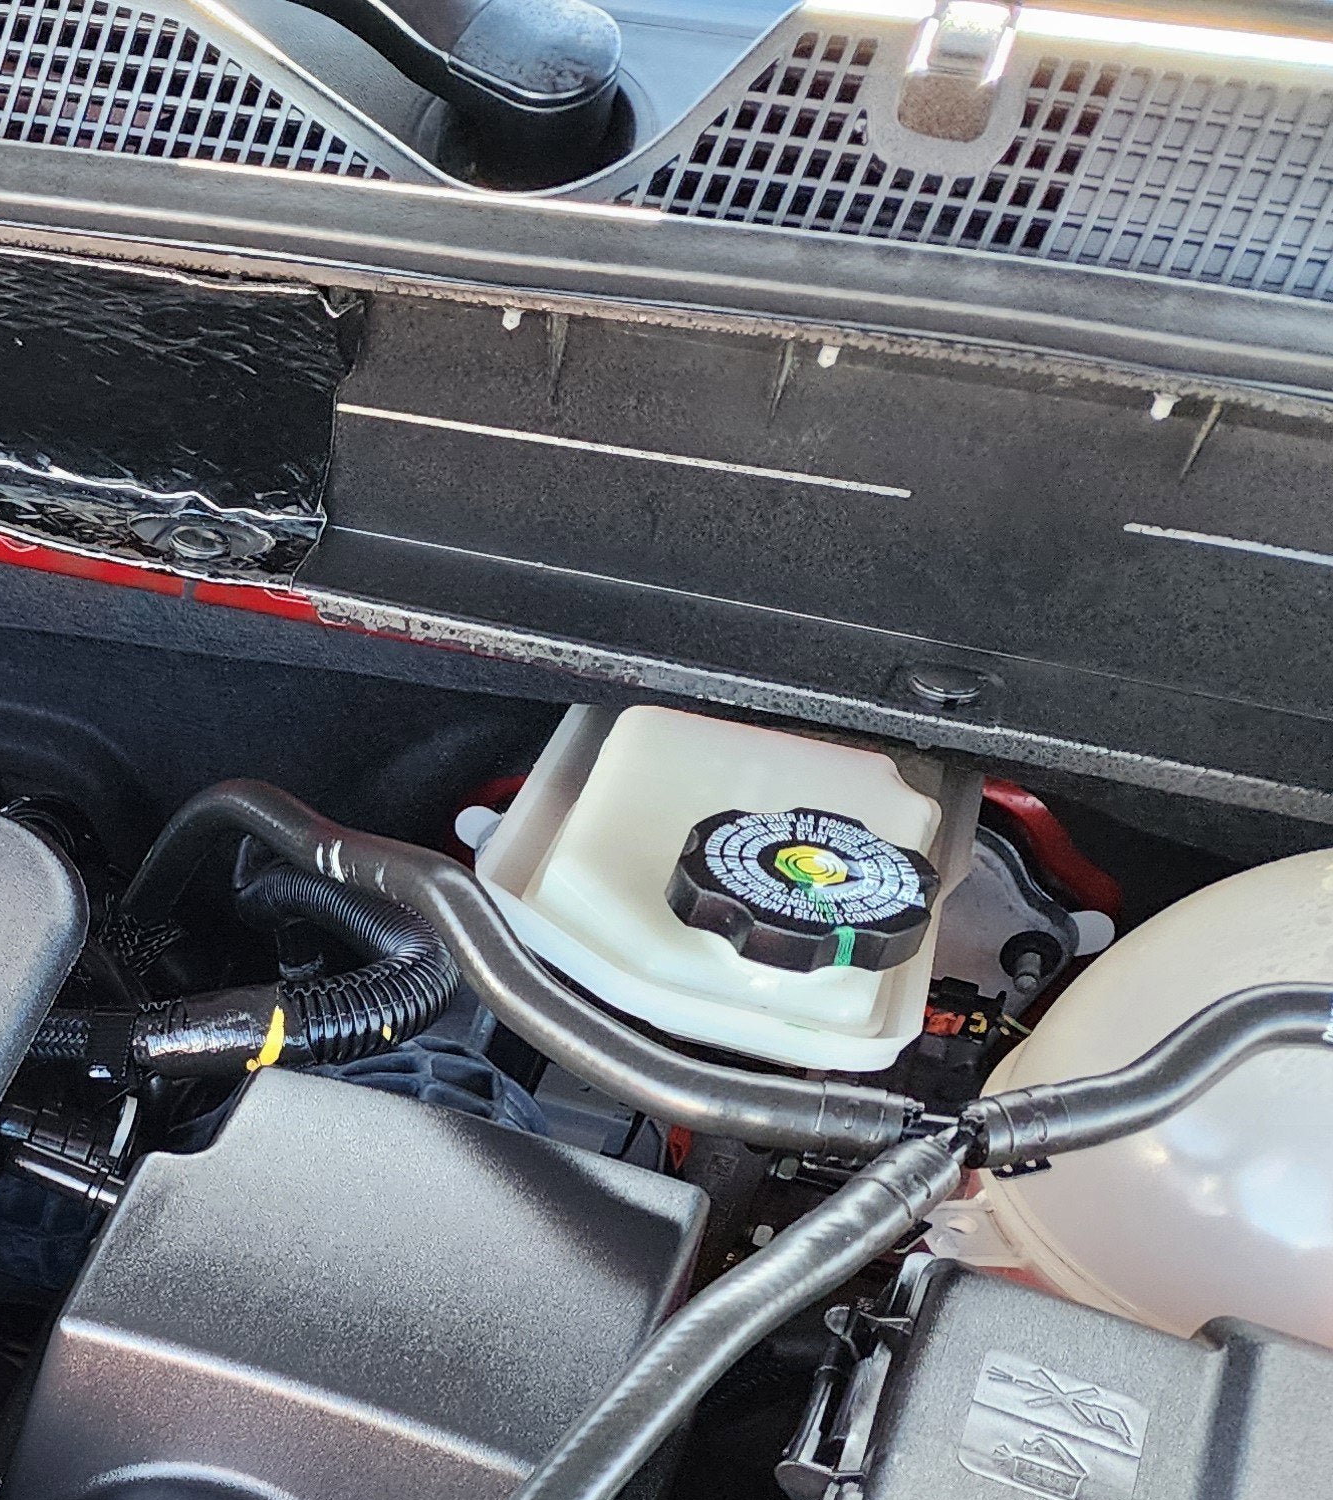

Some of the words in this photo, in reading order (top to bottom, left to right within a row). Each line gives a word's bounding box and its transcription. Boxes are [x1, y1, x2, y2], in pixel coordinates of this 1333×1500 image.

[818, 816, 878, 842] BOUCHON
[743, 892, 784, 913] FROM
[780, 906, 792, 916] A
[792, 907, 843, 924] SEALED
[842, 900, 868, 912] USE
